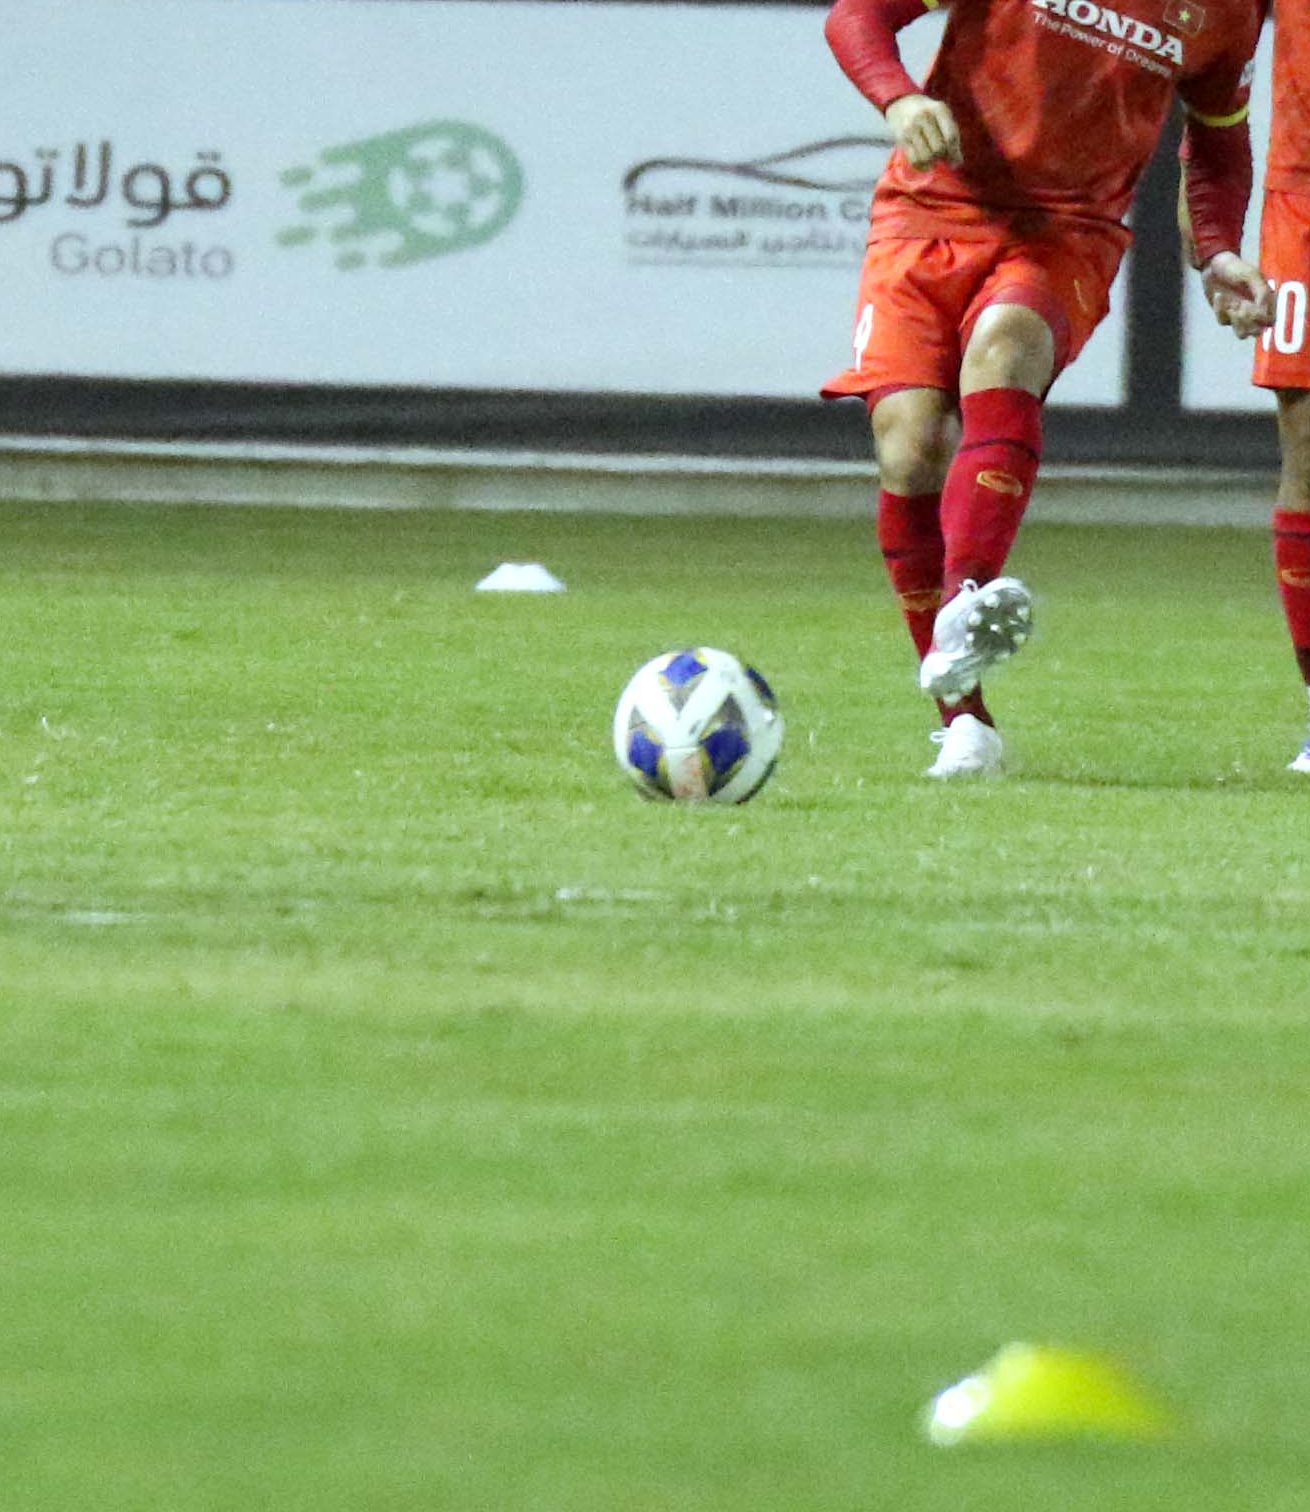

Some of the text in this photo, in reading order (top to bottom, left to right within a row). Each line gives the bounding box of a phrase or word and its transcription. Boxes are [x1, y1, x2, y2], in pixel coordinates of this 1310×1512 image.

[1033, 11, 1061, 32] The
[1059, 22, 1108, 50] Power
[1106, 41, 1125, 57] of
[49, 231, 235, 280] Golato
